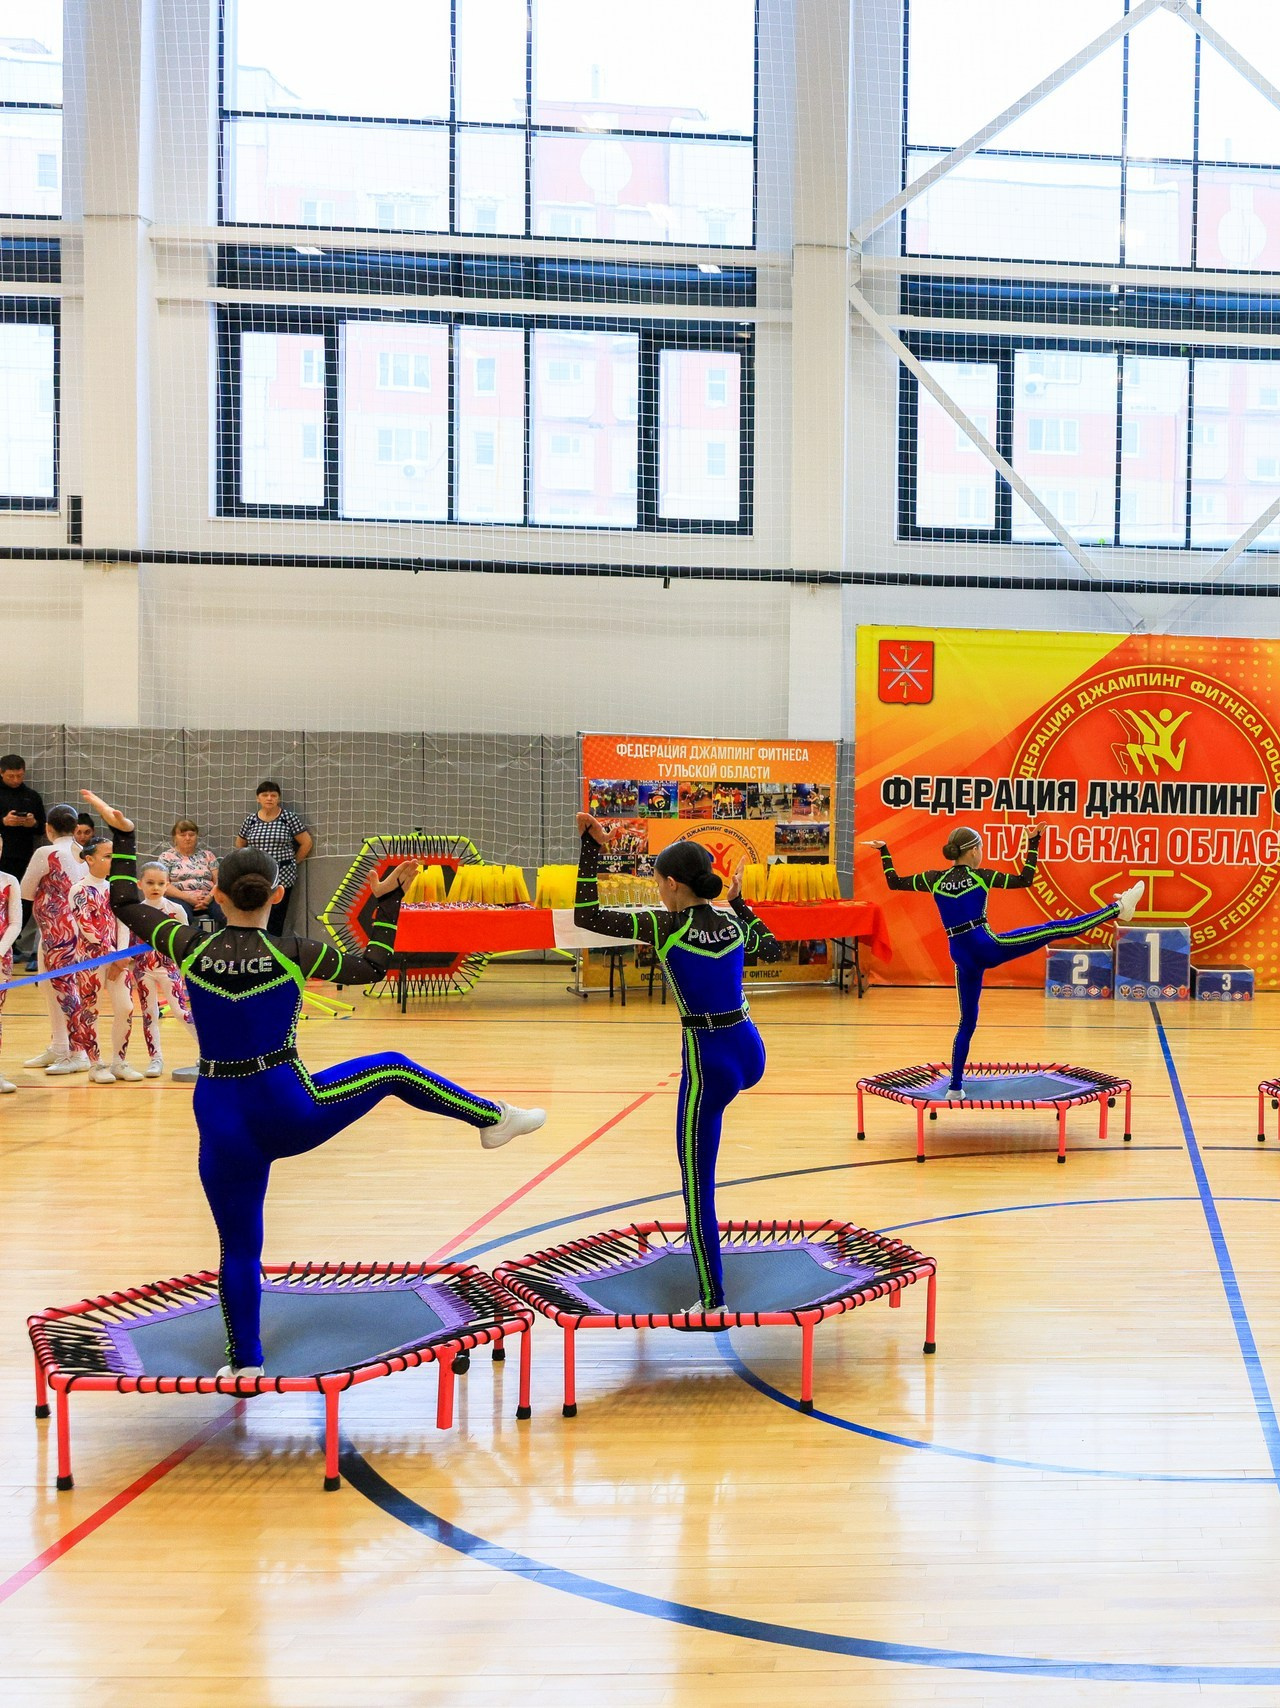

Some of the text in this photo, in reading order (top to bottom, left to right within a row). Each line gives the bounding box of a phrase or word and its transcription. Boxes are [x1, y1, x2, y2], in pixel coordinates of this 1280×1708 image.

[1019, 703, 1075, 778] ДЕРАЦИЯ
[1077, 673, 1185, 710] ДЖАМПИНГ
[1190, 680, 1263, 739] ФИТНЕСА
[617, 743, 809, 761] ФЕДЕРАЦИЯ ДЖАМПИНГ ФИТНЕСА
[658, 763, 770, 779] ТУЛЬСКОЙ ОБЛАСТИ
[882, 775, 1077, 816] ФЕДЕРАЦИЯ
[1084, 781, 1265, 818] ДЖАМПИНГ
[687, 826, 722, 837] ДЖАМПИНГ
[724, 828, 749, 847] ФИТНЕСА
[940, 878, 973, 891] POLICE
[687, 925, 738, 944] POLICE
[201, 955, 273, 975] POLICE
[1145, 932, 1160, 983] 1
[1072, 954, 1089, 985] 2
[1221, 973, 1232, 991] 3
